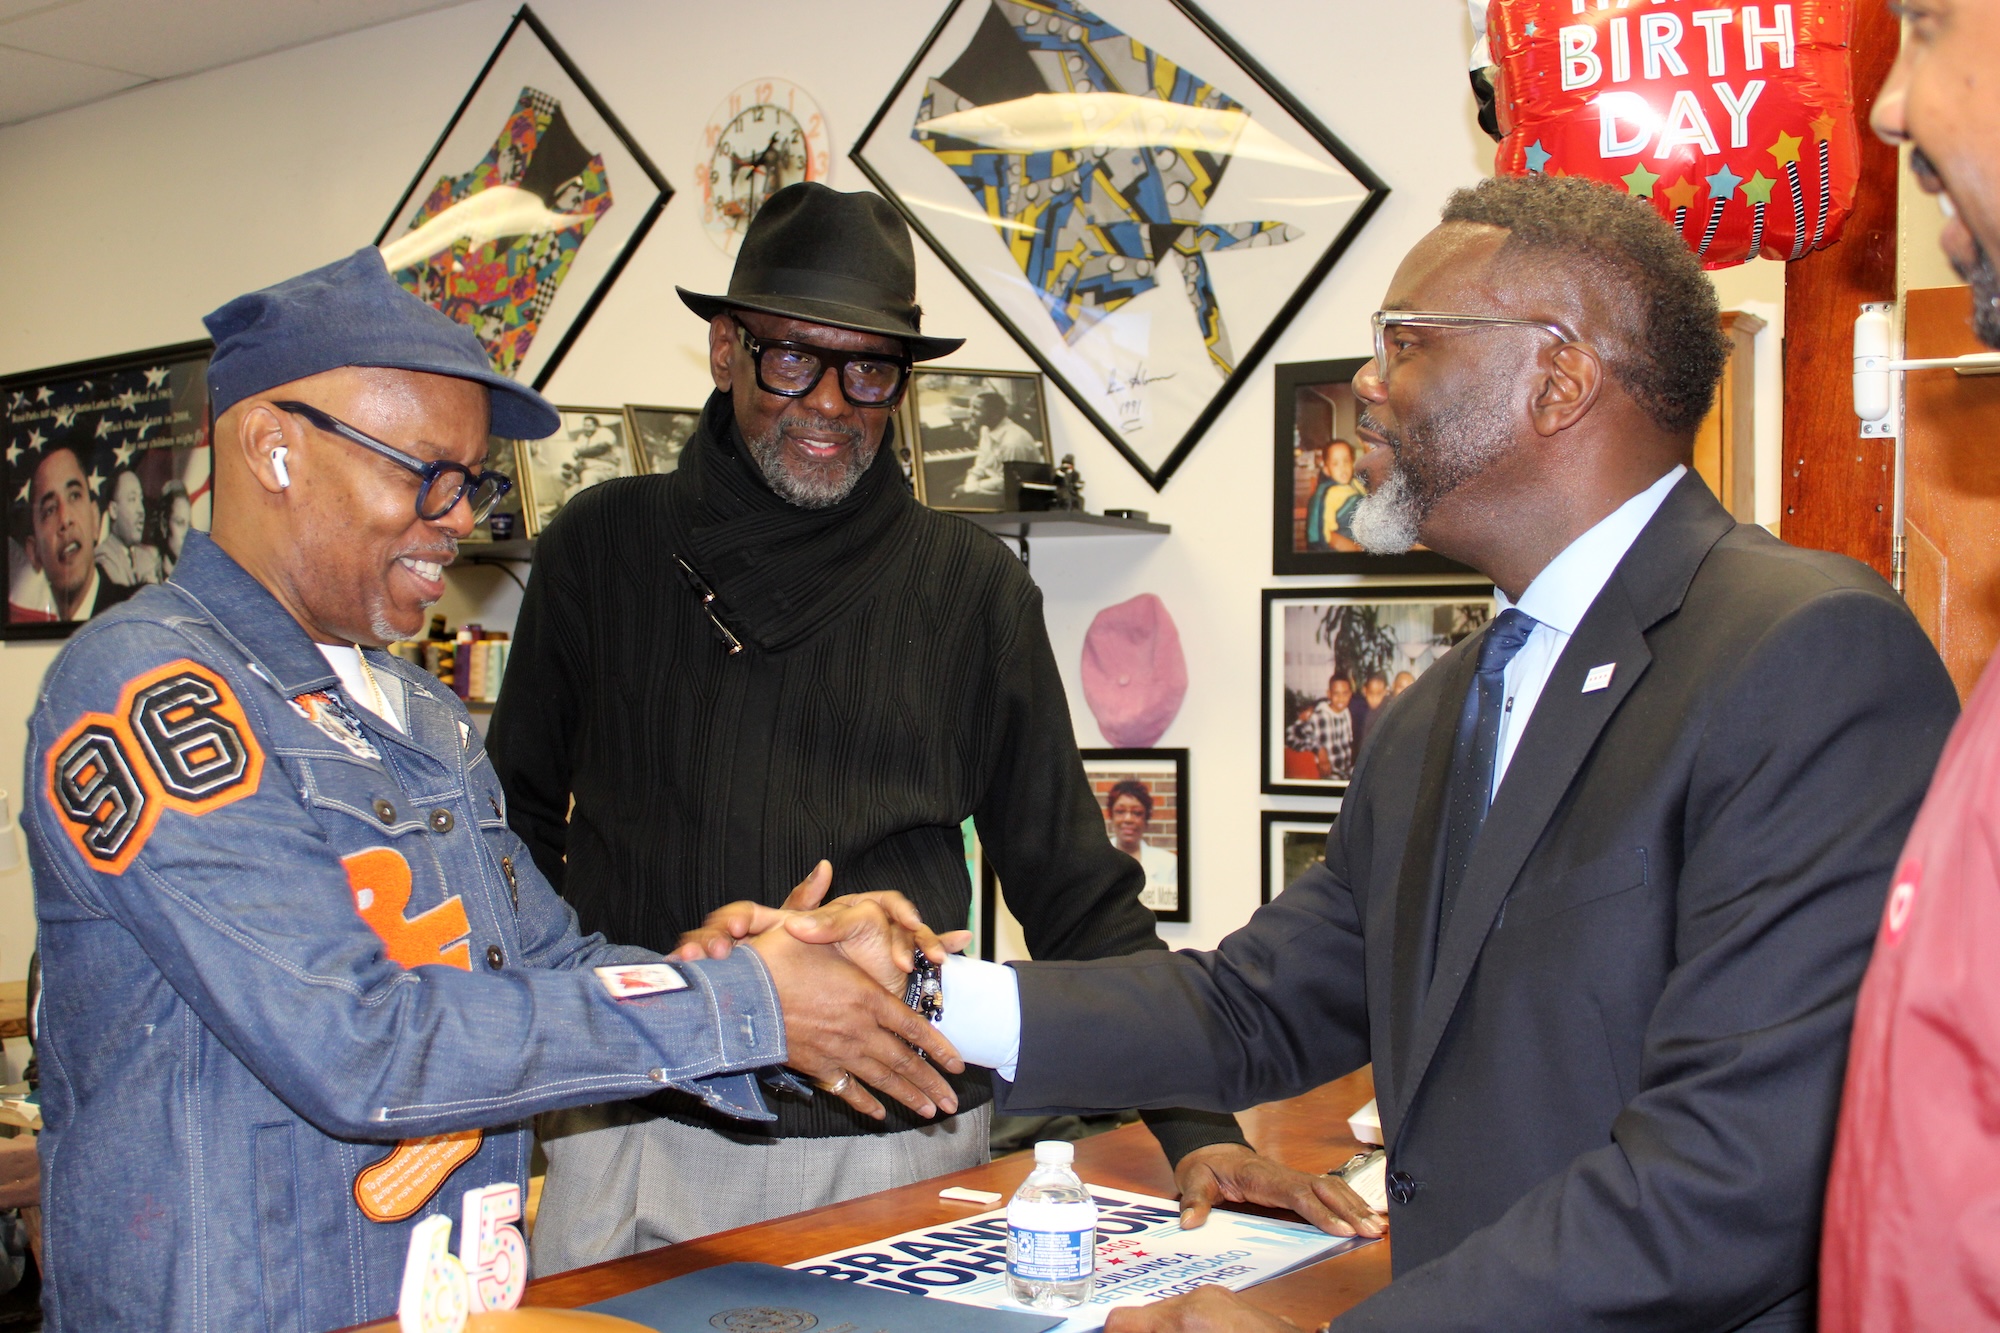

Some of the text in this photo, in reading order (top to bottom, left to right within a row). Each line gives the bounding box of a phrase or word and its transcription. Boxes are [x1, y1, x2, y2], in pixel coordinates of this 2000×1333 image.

[1559, 4, 1795, 92] BIRTH
[755, 83, 773, 104] 12
[752, 106, 764, 122] 12
[775, 109, 781, 124] 1
[1598, 80, 1766, 160] DAY
[735, 118, 744, 132] 11
[808, 113, 822, 138] 2
[791, 128, 800, 143] 2
[797, 154, 805, 169] 3
[814, 152, 828, 175] 3
[710, 170, 719, 184] 9
[52, 668, 249, 862] 96
[1174, 1252, 1201, 1260] A
[1088, 1249, 1252, 1304] BETTER CHICAGO
